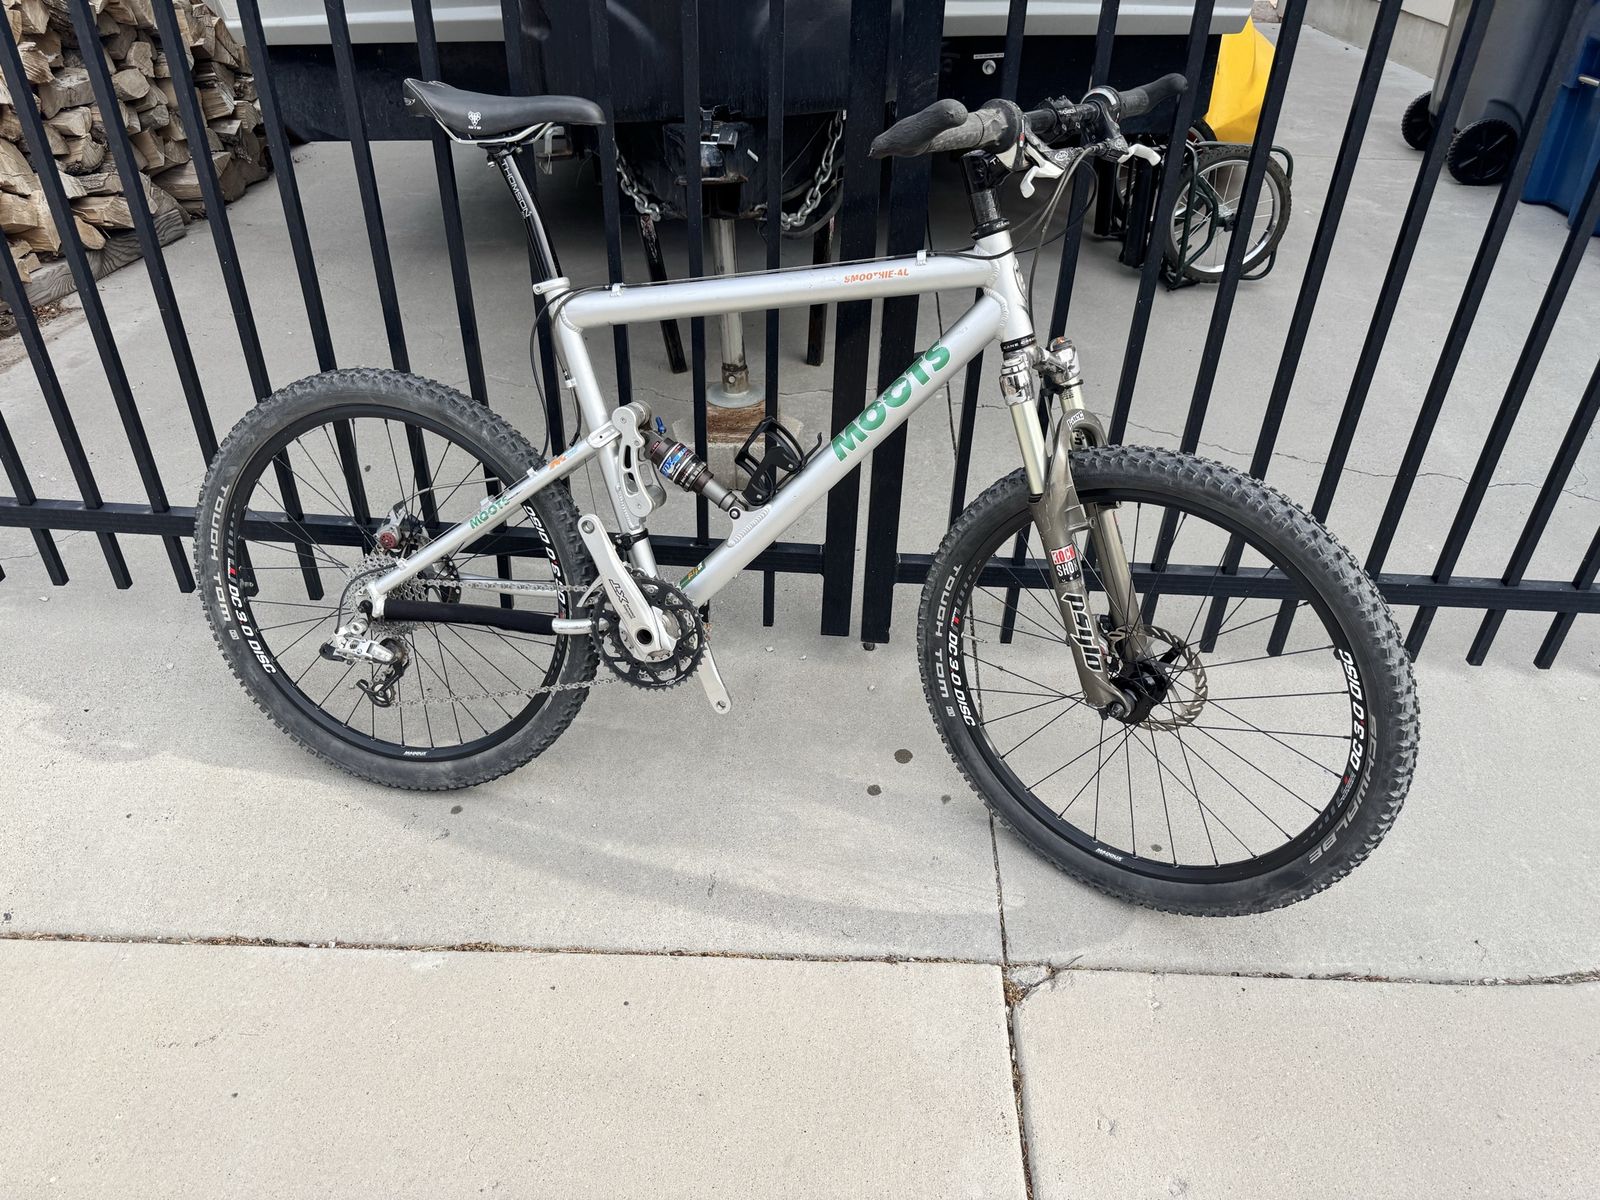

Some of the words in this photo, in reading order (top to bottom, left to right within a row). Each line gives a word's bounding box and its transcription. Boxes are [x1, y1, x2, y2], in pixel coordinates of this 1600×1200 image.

[501, 158, 533, 218] THOMSON
[831, 339, 951, 463] MOOTS
[210, 484, 230, 561] TOUGH
[469, 494, 511, 530] MOOTS
[523, 504, 551, 545] DISC
[212, 571, 232, 622] TOM
[935, 563, 963, 637] TOUGH
[228, 583, 243, 608] DC
[247, 639, 277, 674] DISC
[934, 648, 950, 698] TOM
[948, 631, 958, 656] DC
[955, 687, 976, 727] DISC
[1338, 648, 1363, 701] DISC
[1349, 738, 1363, 771] DC
[1308, 711, 1377, 865] SCHWALBE
